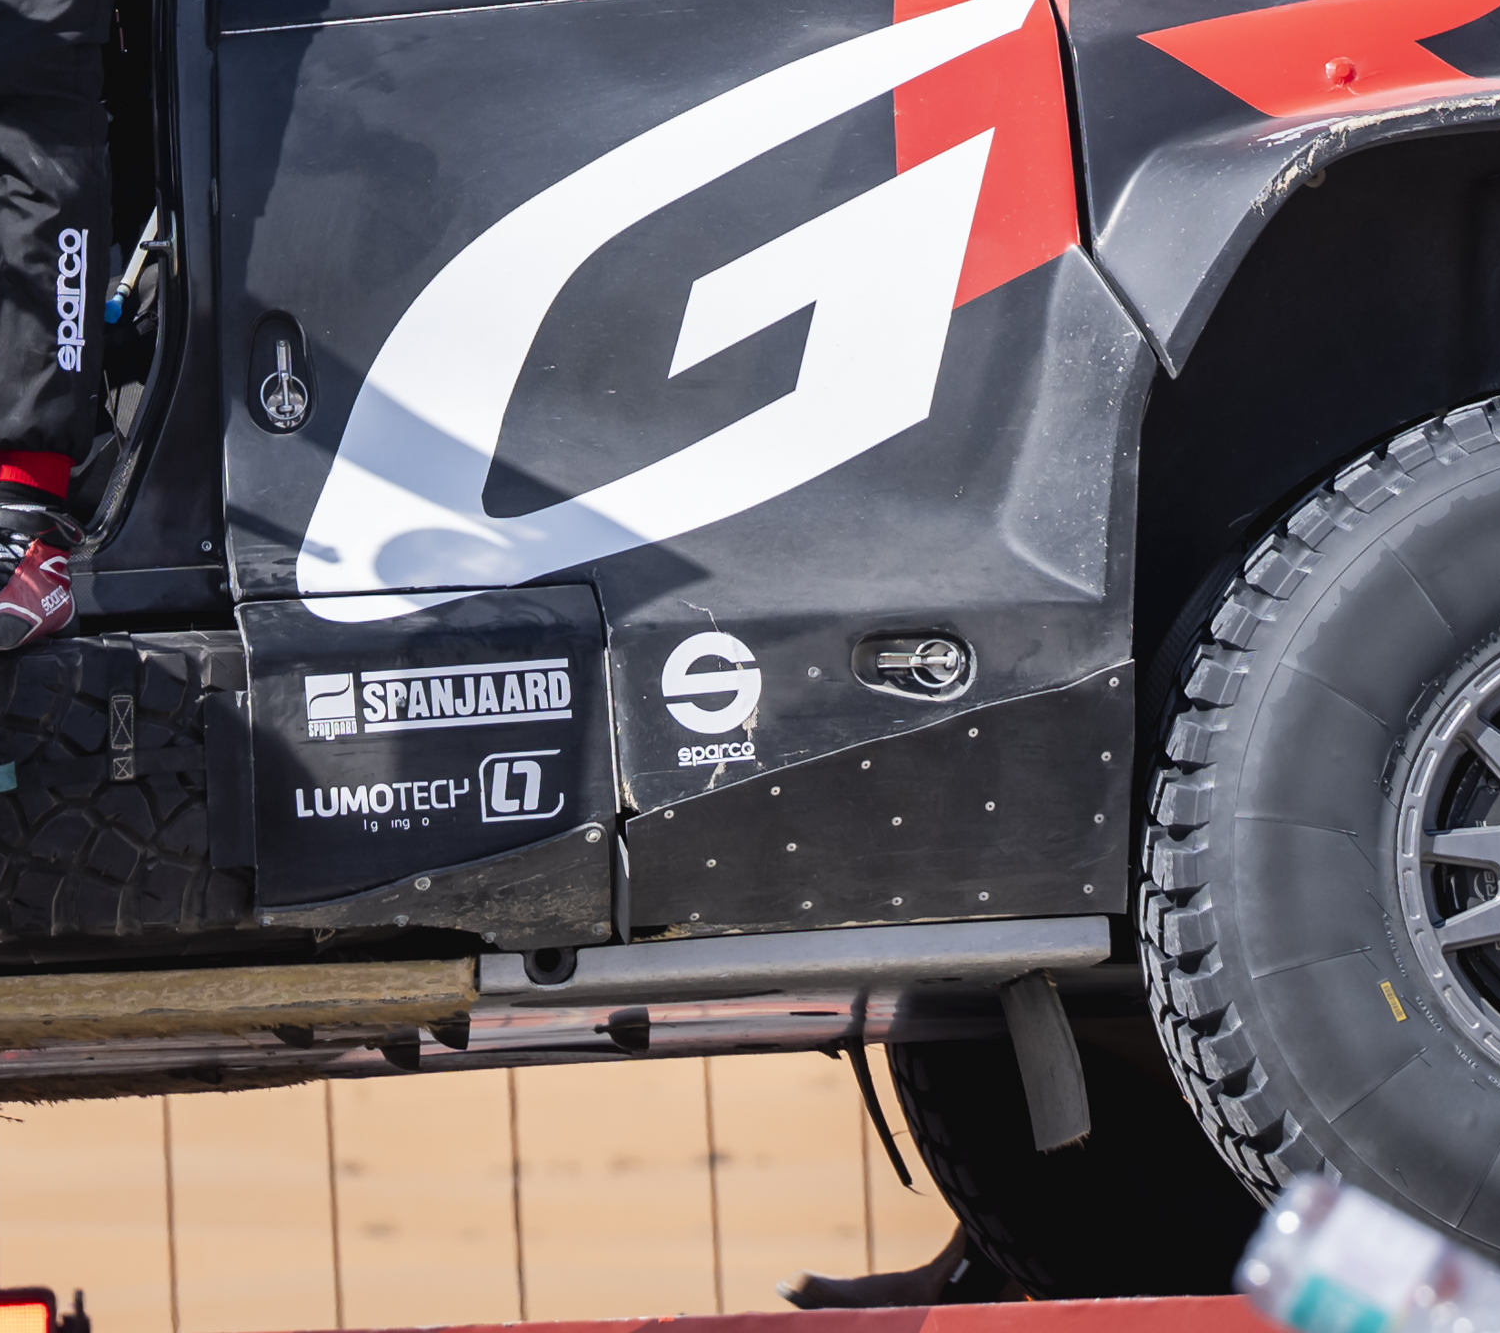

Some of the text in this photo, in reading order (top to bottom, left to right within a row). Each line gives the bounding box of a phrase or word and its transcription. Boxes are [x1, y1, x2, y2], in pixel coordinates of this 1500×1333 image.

[57, 228, 87, 371] sparco
[362, 670, 572, 722] SPANJAARD
[678, 741, 755, 767] sparco
[296, 778, 470, 818] LUMOTECH
